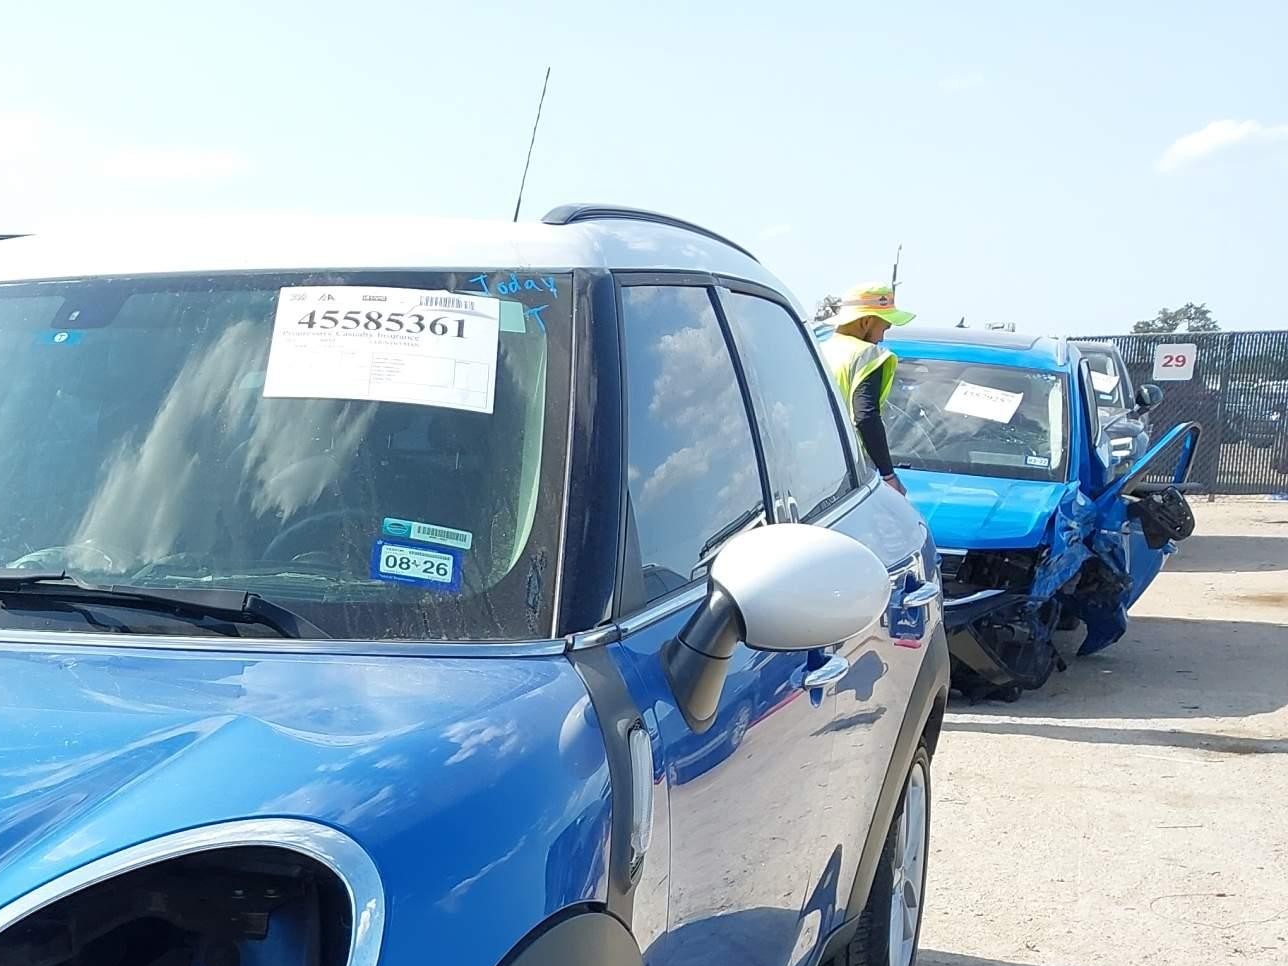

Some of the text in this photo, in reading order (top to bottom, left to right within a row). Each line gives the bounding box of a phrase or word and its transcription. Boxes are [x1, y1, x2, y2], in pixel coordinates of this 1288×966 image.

[469, 271, 558, 299] Today
[297, 309, 468, 339] 45585361
[1161, 354, 1187, 368] 29
[385, 554, 411, 571] 08
[422, 560, 448, 577] 26
